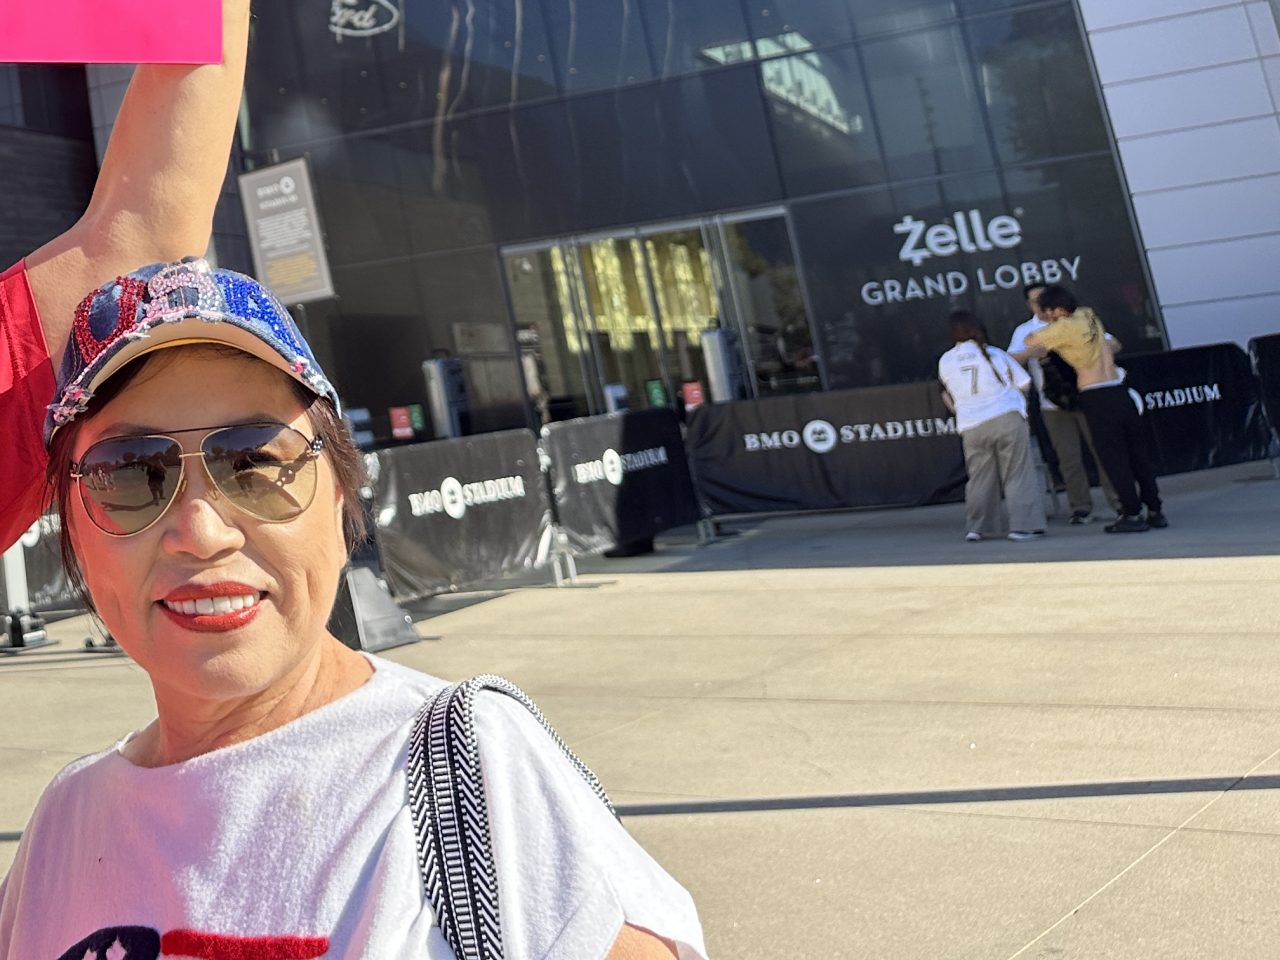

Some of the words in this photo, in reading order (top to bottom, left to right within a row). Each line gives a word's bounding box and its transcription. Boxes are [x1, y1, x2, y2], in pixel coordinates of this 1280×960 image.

[860, 271, 968, 307] GRAND
[976, 255, 1081, 291] LOBBY
[959, 364, 978, 396] 7
[1144, 384, 1221, 410] STADIUM
[743, 429, 801, 452] BMO
[840, 416, 957, 443] STADIUM
